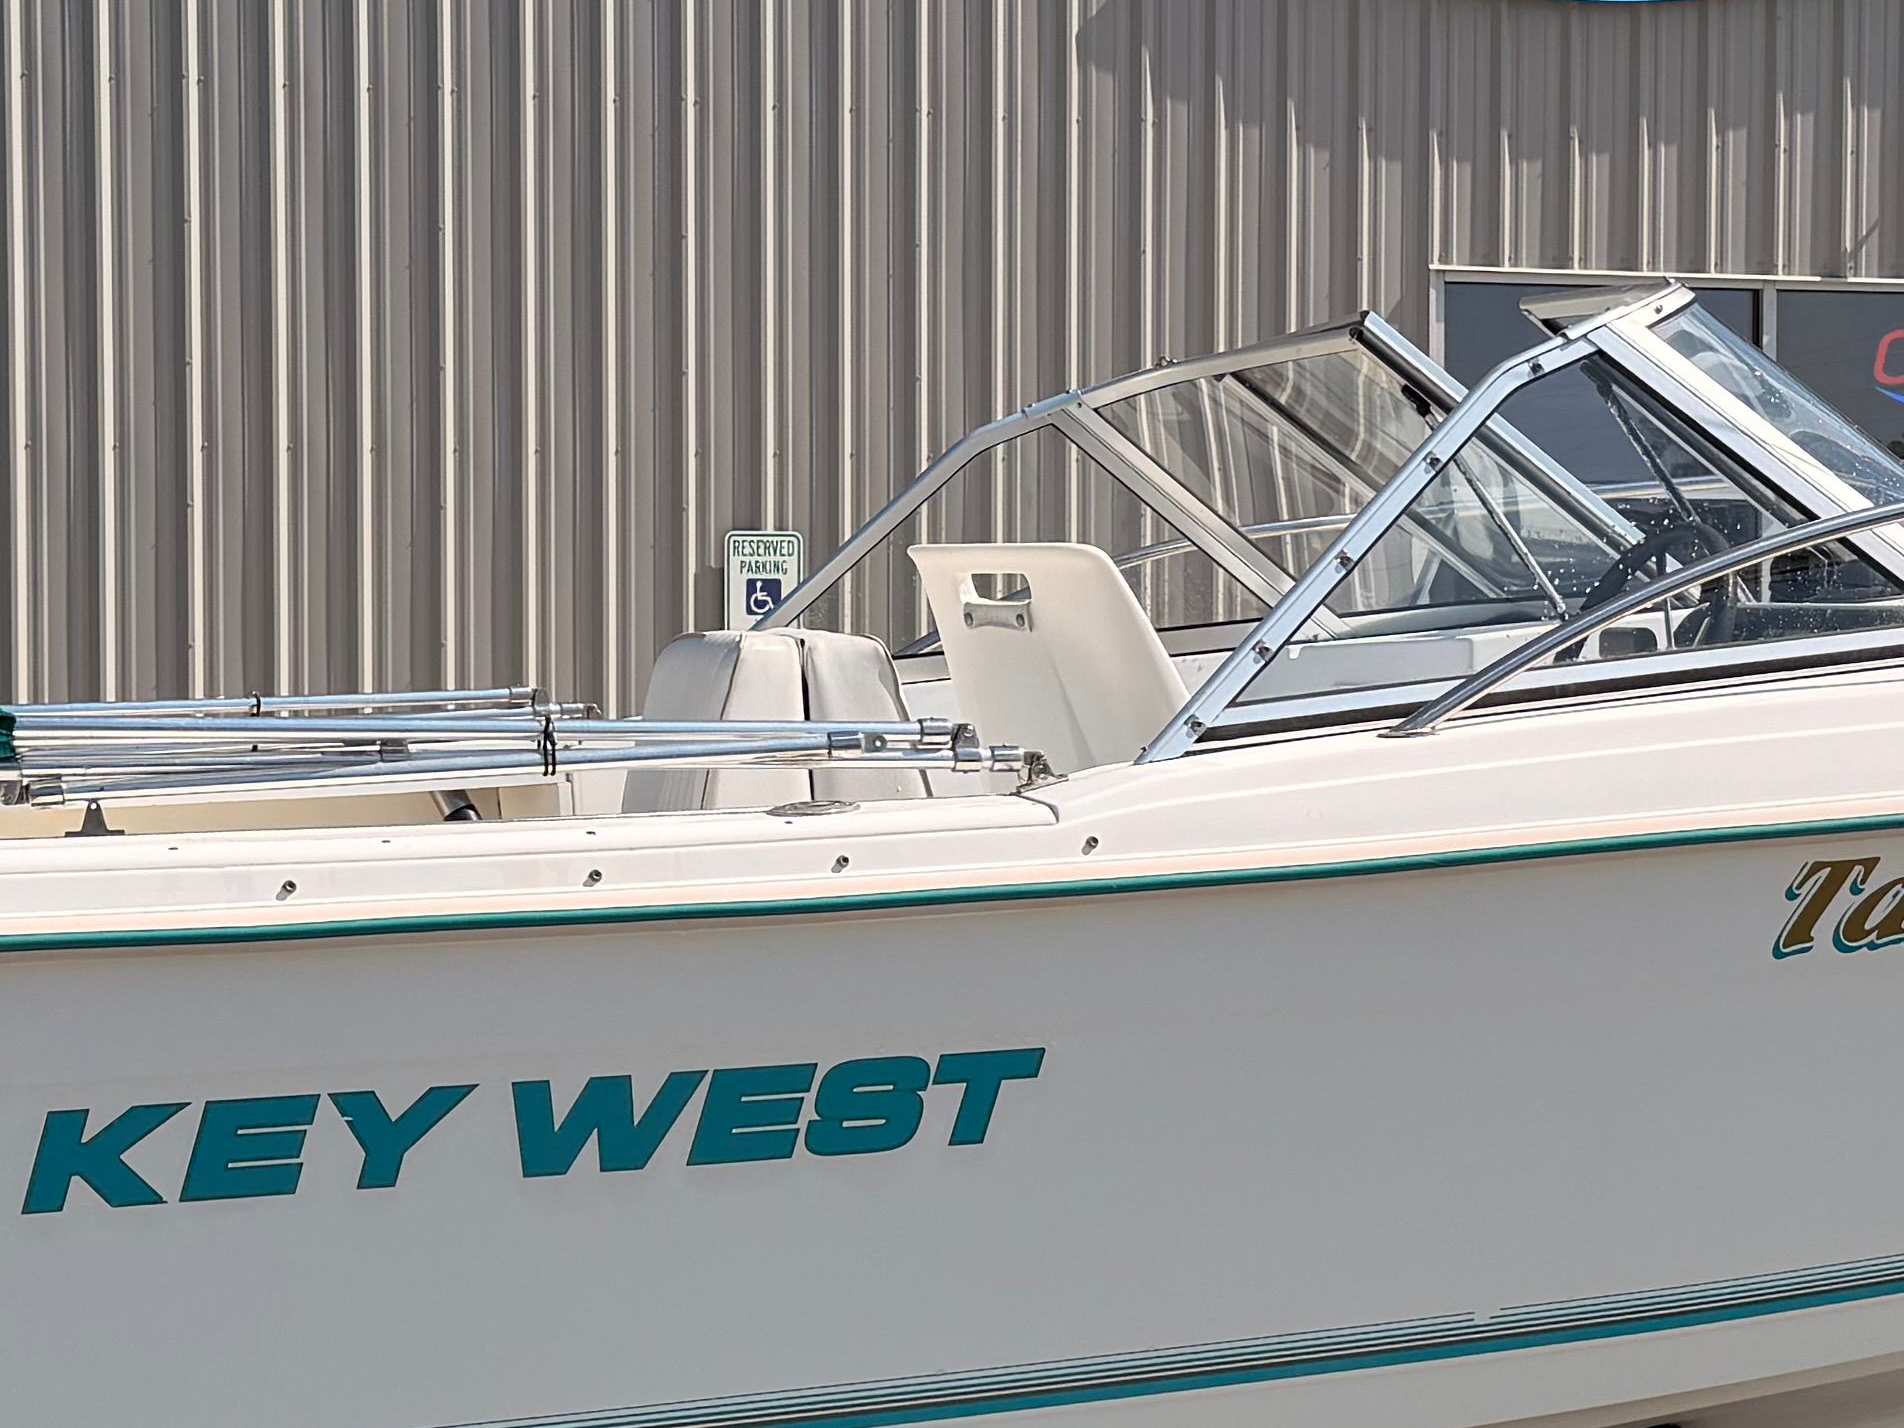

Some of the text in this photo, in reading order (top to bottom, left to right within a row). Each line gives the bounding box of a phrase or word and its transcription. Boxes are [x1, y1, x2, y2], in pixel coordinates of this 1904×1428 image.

[732, 539, 795, 557] RESERVED
[739, 560, 788, 575] PARKING
[20, 1047, 1046, 1215] KEY WEST
